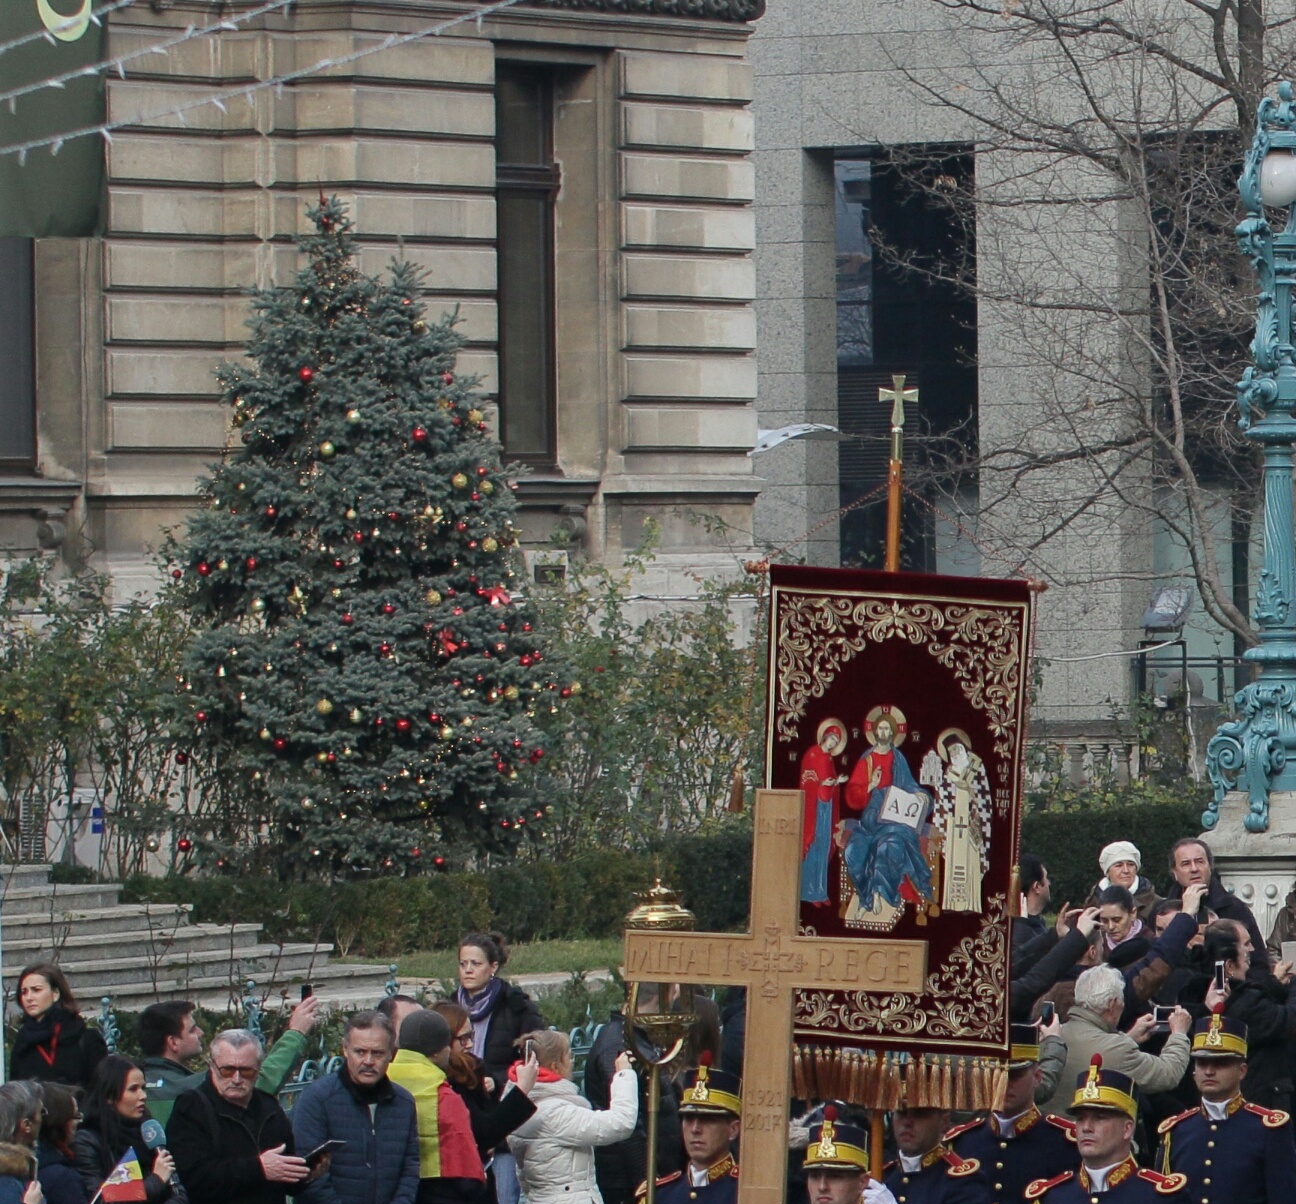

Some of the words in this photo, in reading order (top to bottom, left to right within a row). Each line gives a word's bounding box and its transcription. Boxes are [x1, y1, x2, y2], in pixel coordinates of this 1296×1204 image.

[814, 947, 911, 984] REGE
[748, 1089, 783, 1107] 1921
[745, 1112, 783, 1132] 2017
